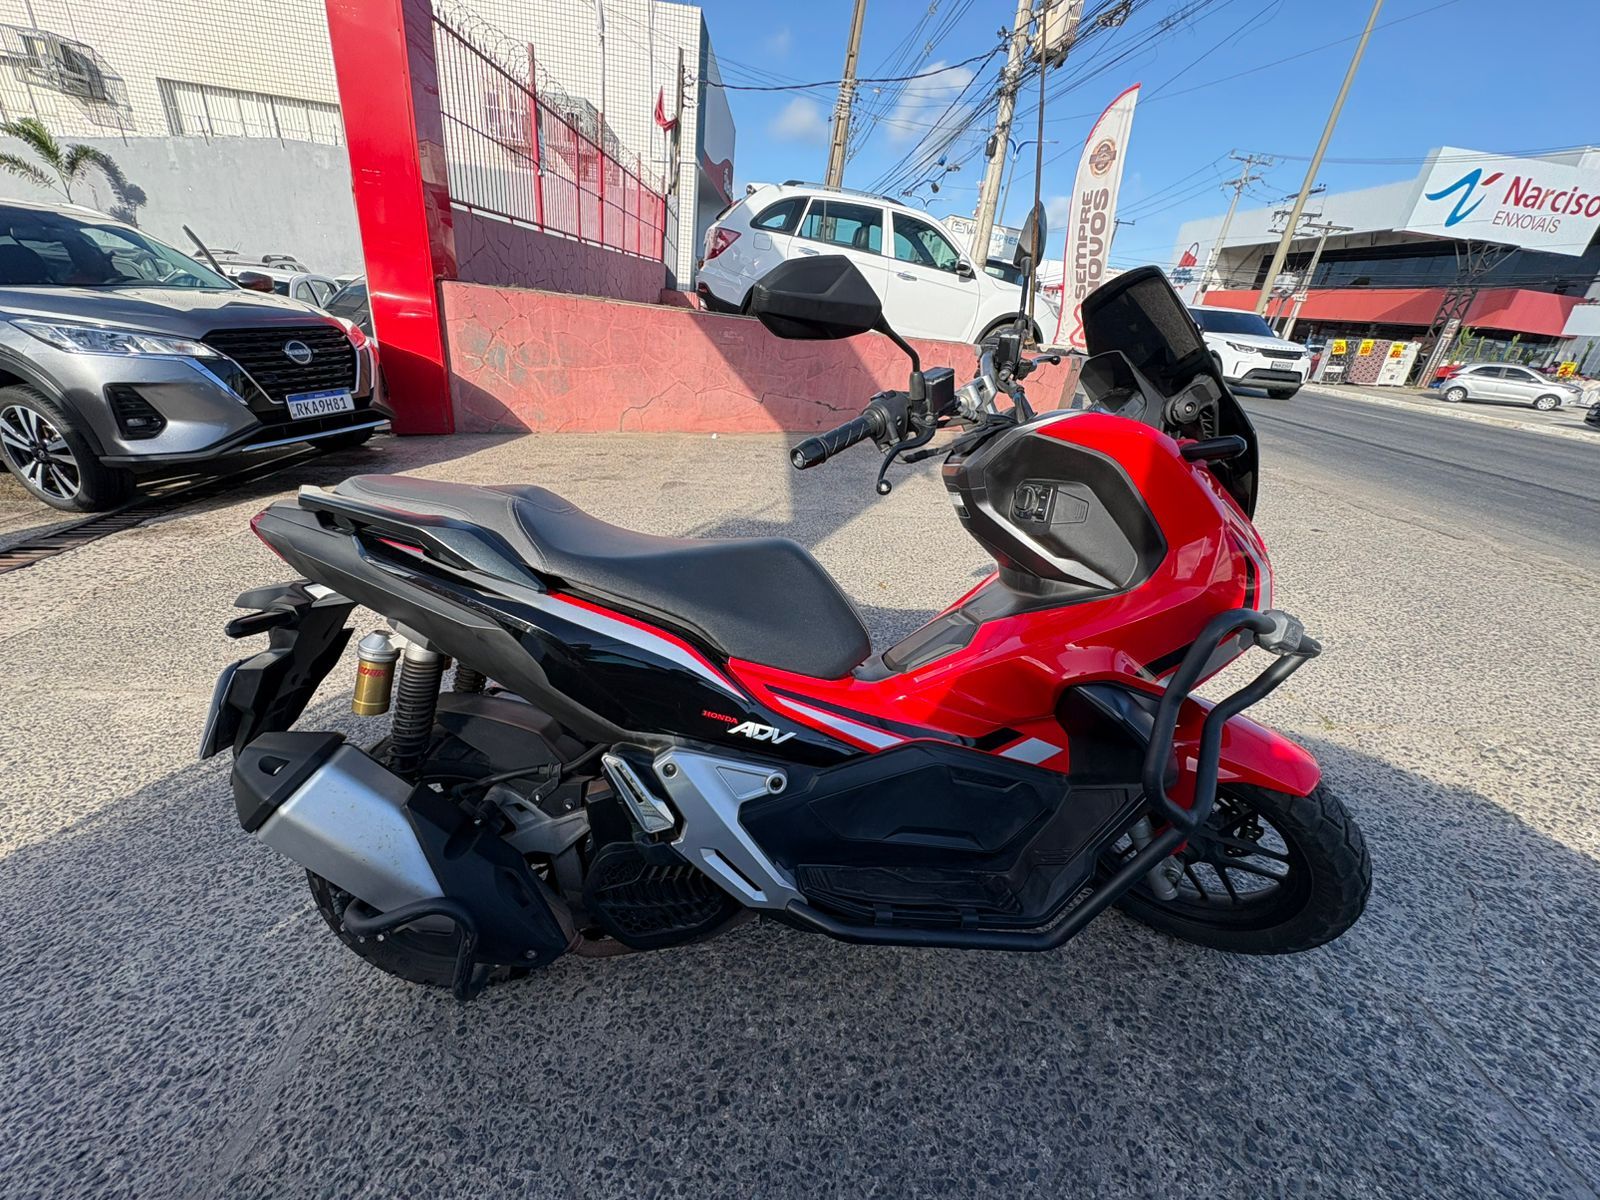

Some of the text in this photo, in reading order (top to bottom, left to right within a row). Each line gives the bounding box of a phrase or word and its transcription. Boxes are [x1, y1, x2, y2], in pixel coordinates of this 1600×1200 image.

[1502, 175, 1600, 218] Narciso
[1074, 189, 1095, 300] SEMPRE
[295, 396, 348, 416] RKA9H81
[702, 709, 738, 725] HONDA
[727, 721, 797, 744] ADV
